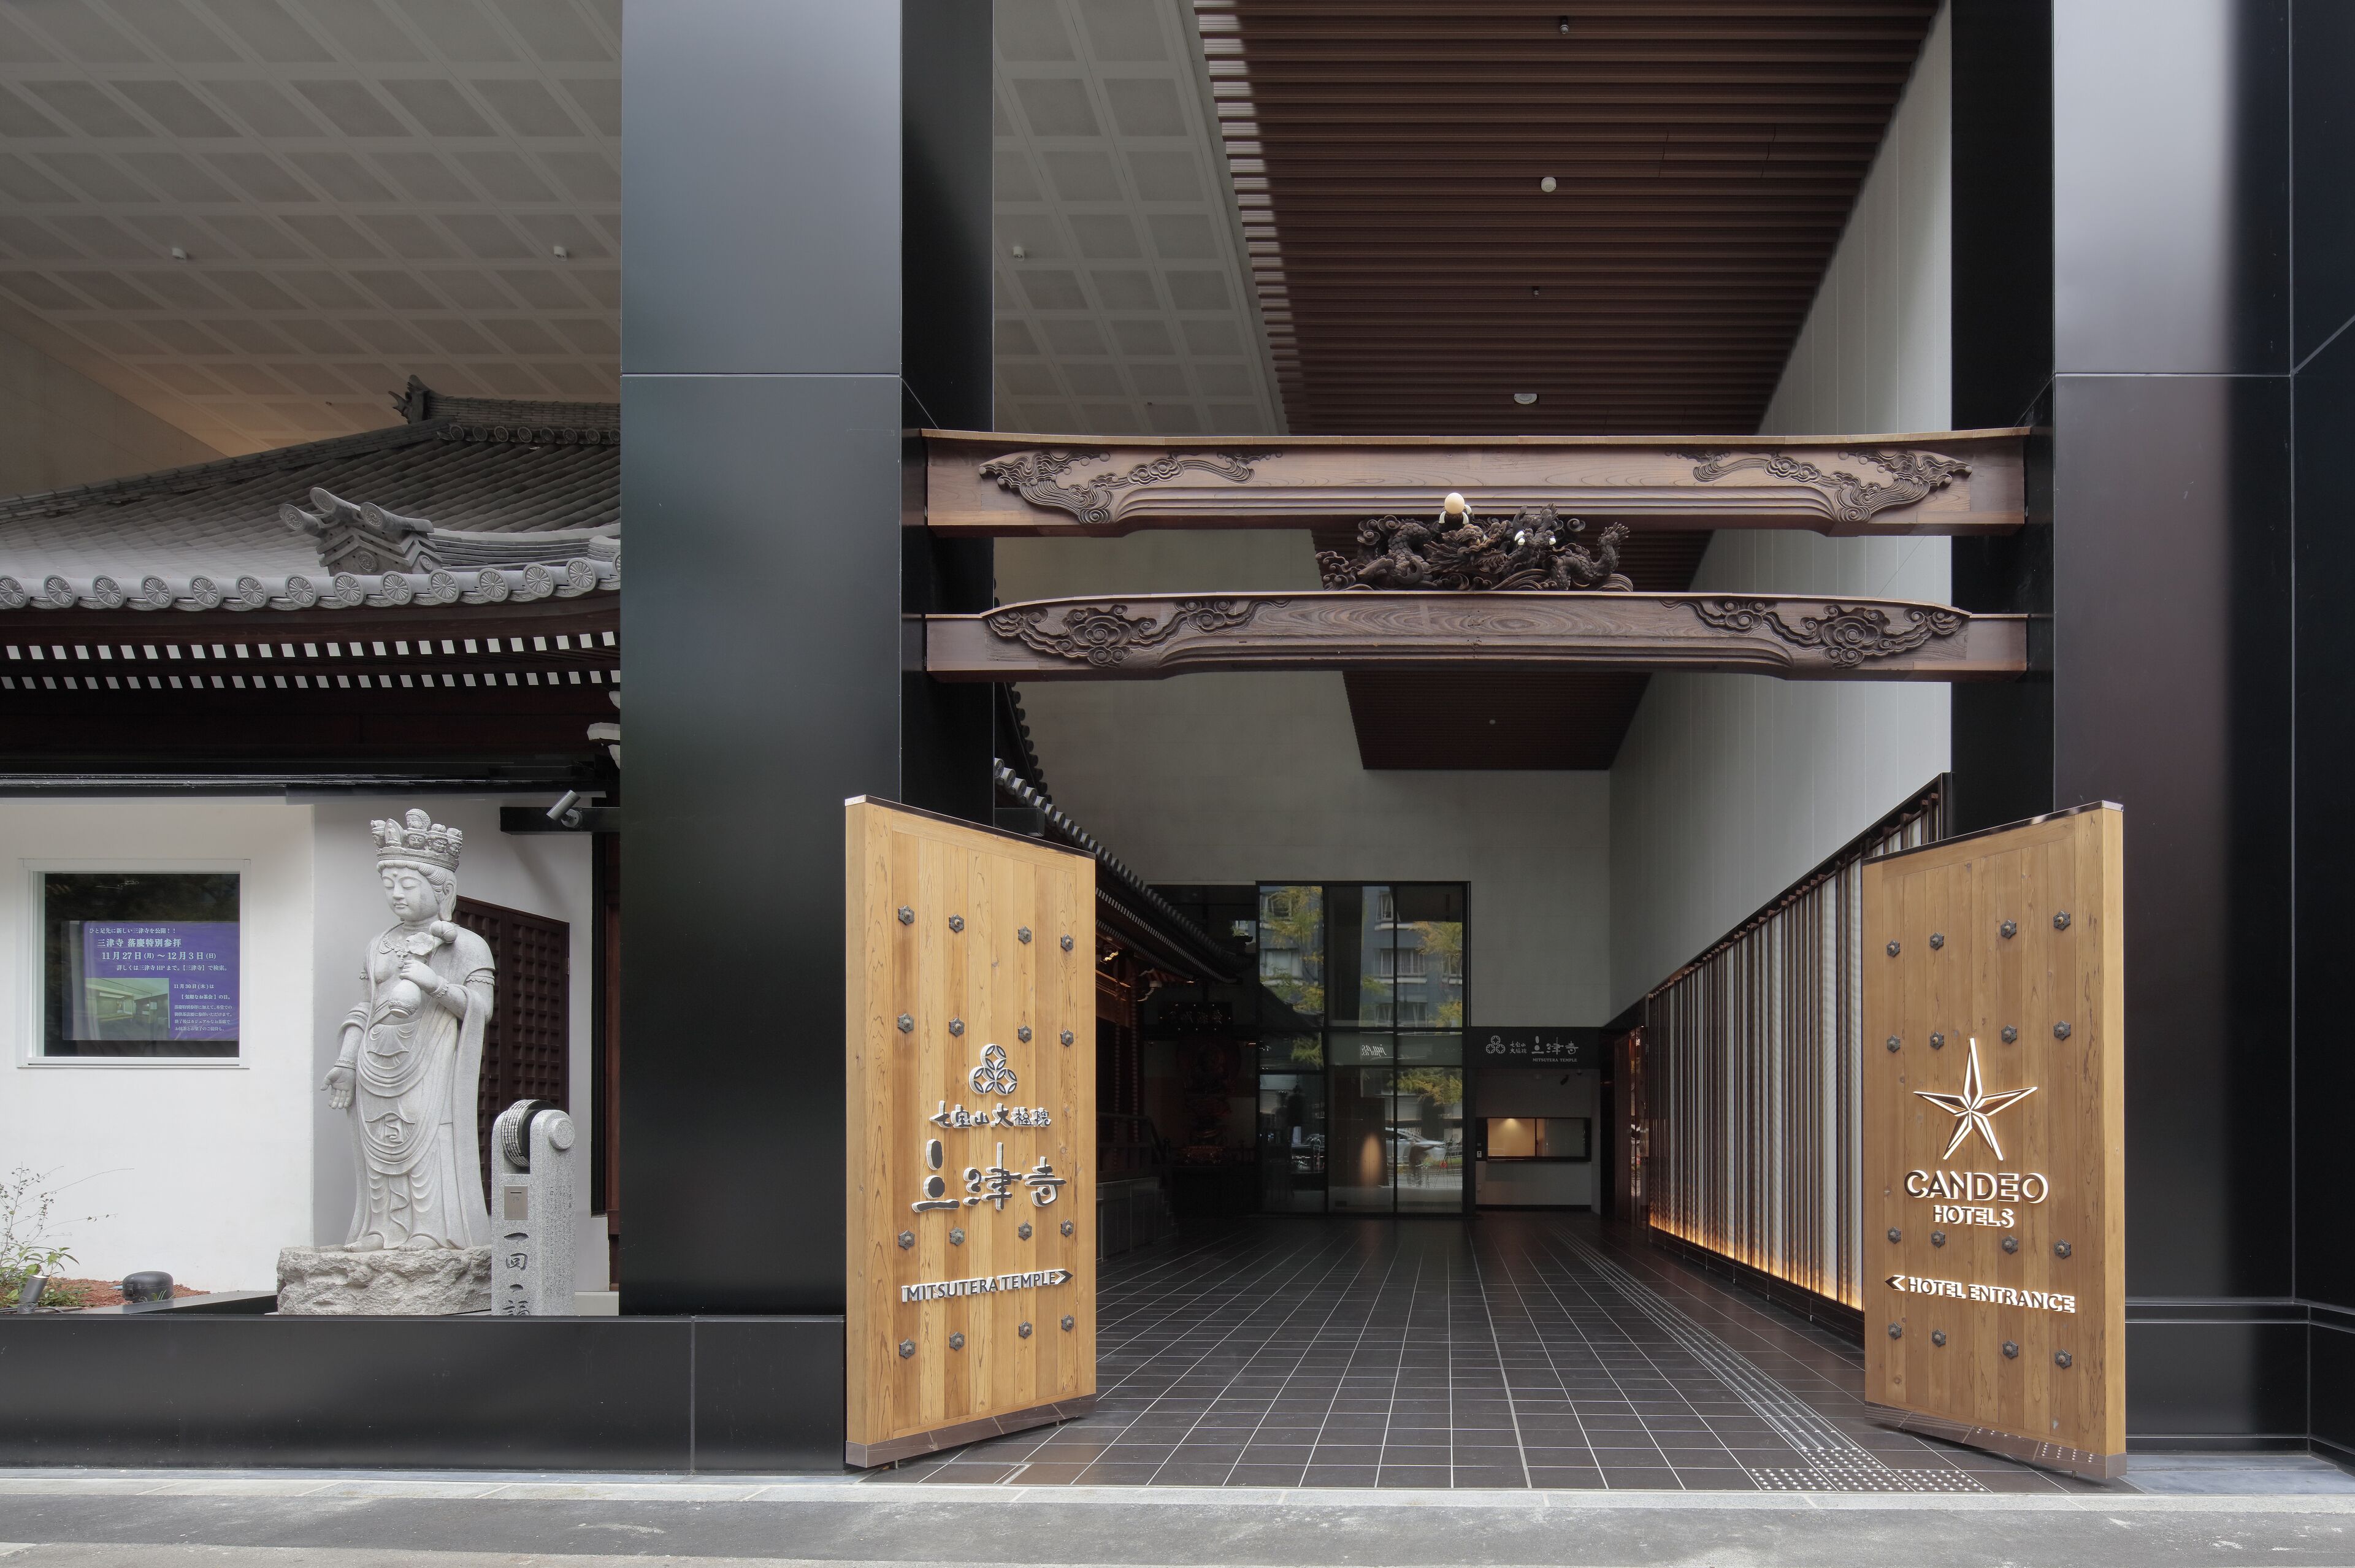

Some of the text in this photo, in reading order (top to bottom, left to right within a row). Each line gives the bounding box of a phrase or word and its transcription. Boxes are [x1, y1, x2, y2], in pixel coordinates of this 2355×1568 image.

[97, 938, 183, 947] 三津寺 落慶特別参拝
[1904, 1169, 2049, 1204] CANDEO
[1933, 1204, 2015, 1228] HOTELS
[902, 1269, 1057, 1302] MITSUTERA TEMPLE
[1907, 1276, 2076, 1314] HOTEL ENTRANCE
